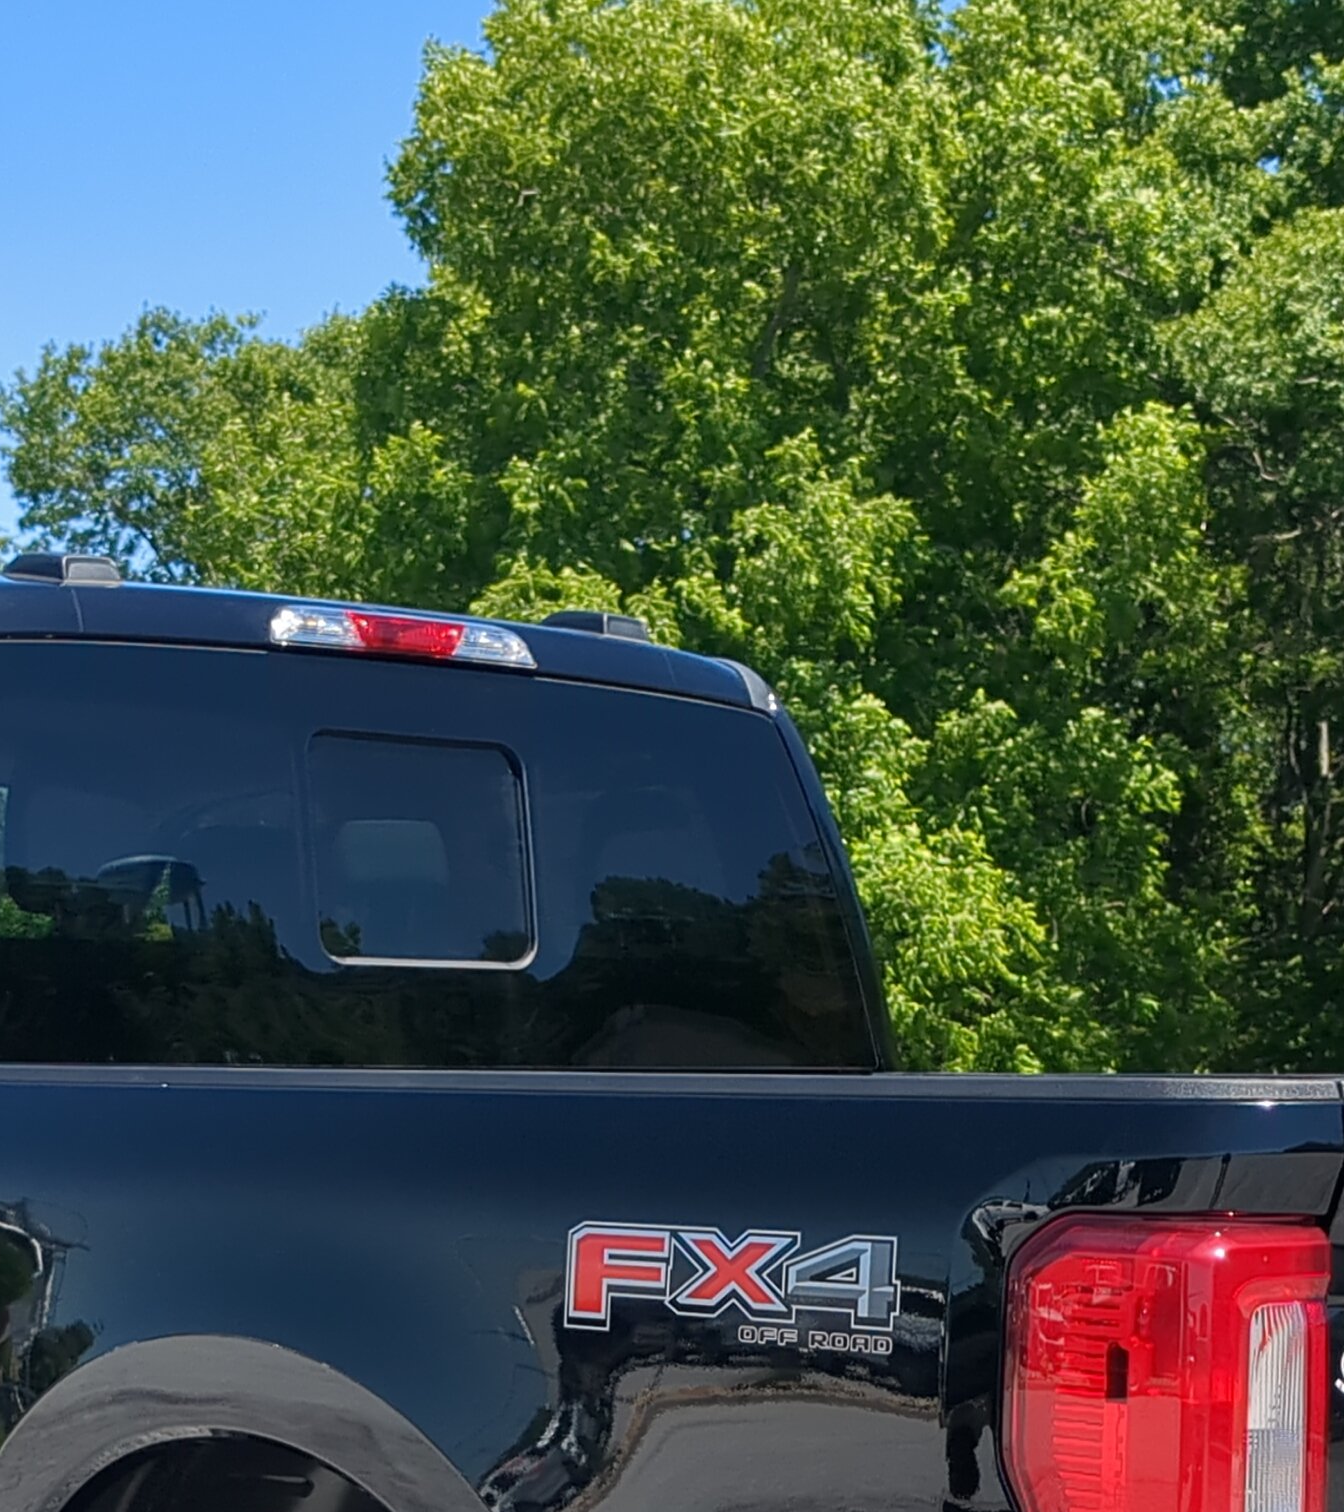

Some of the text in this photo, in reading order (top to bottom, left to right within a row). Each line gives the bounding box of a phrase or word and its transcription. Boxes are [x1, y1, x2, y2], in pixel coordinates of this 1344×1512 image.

[564, 1221, 900, 1331] FX4
[738, 1325, 893, 1354] OFF ROAD
